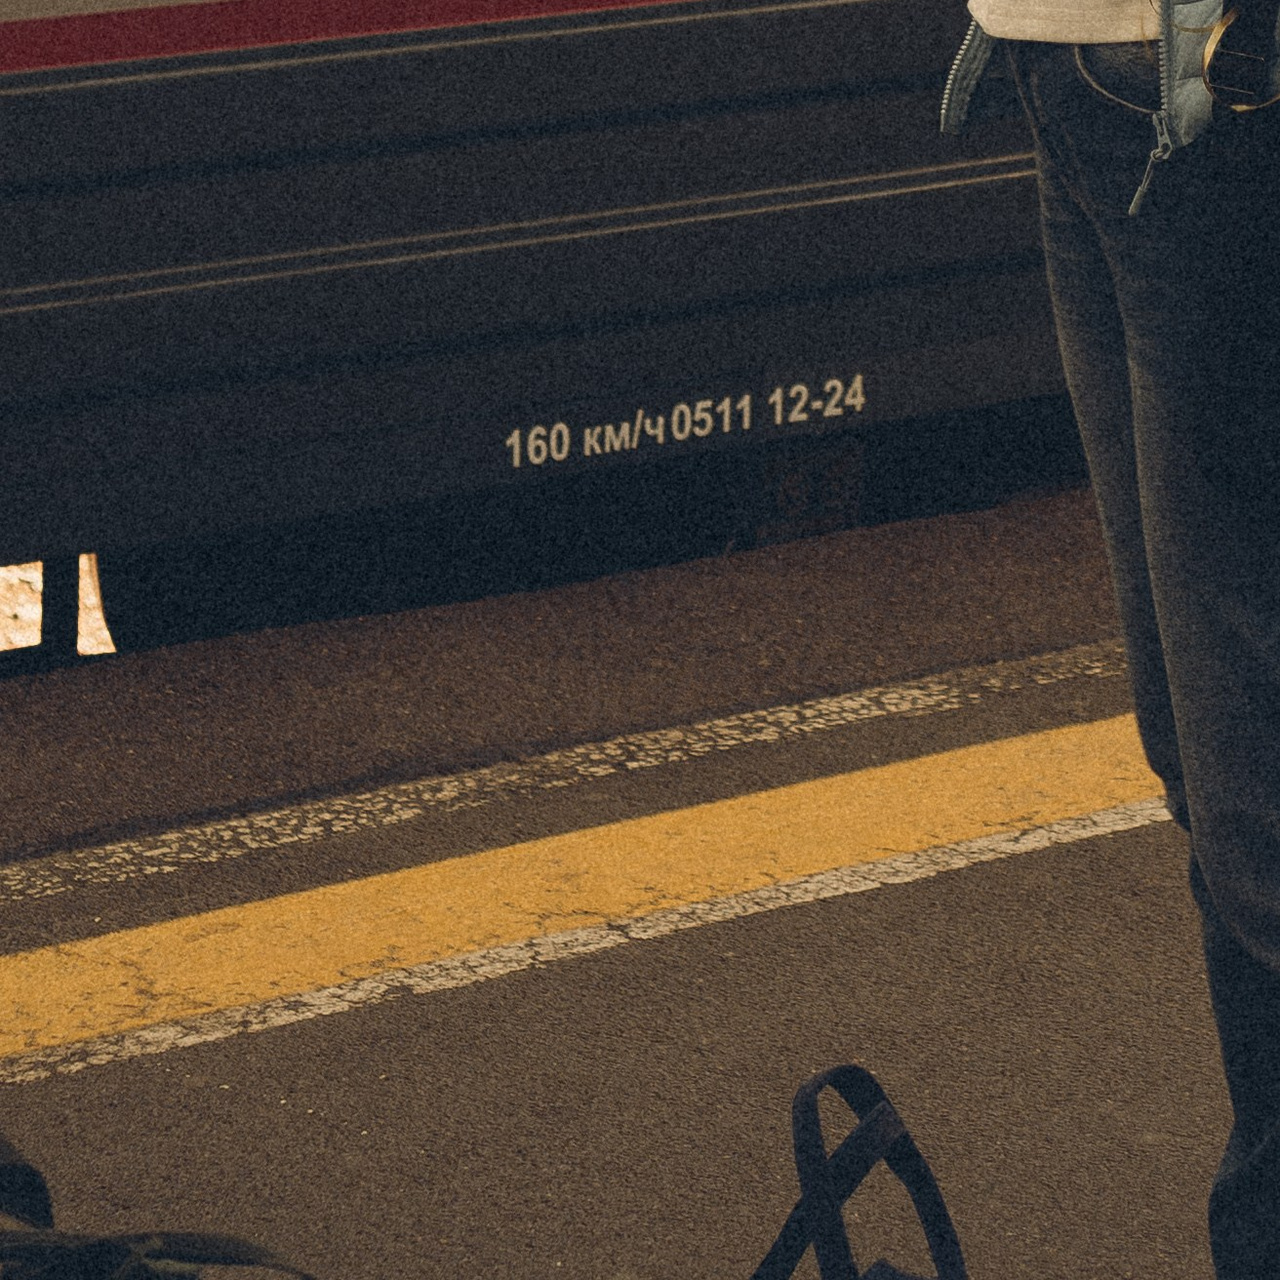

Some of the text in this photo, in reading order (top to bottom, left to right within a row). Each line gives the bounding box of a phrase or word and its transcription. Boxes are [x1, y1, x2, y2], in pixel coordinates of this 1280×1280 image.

[505, 374, 866, 468] 160 км/ч 0511 12-24
